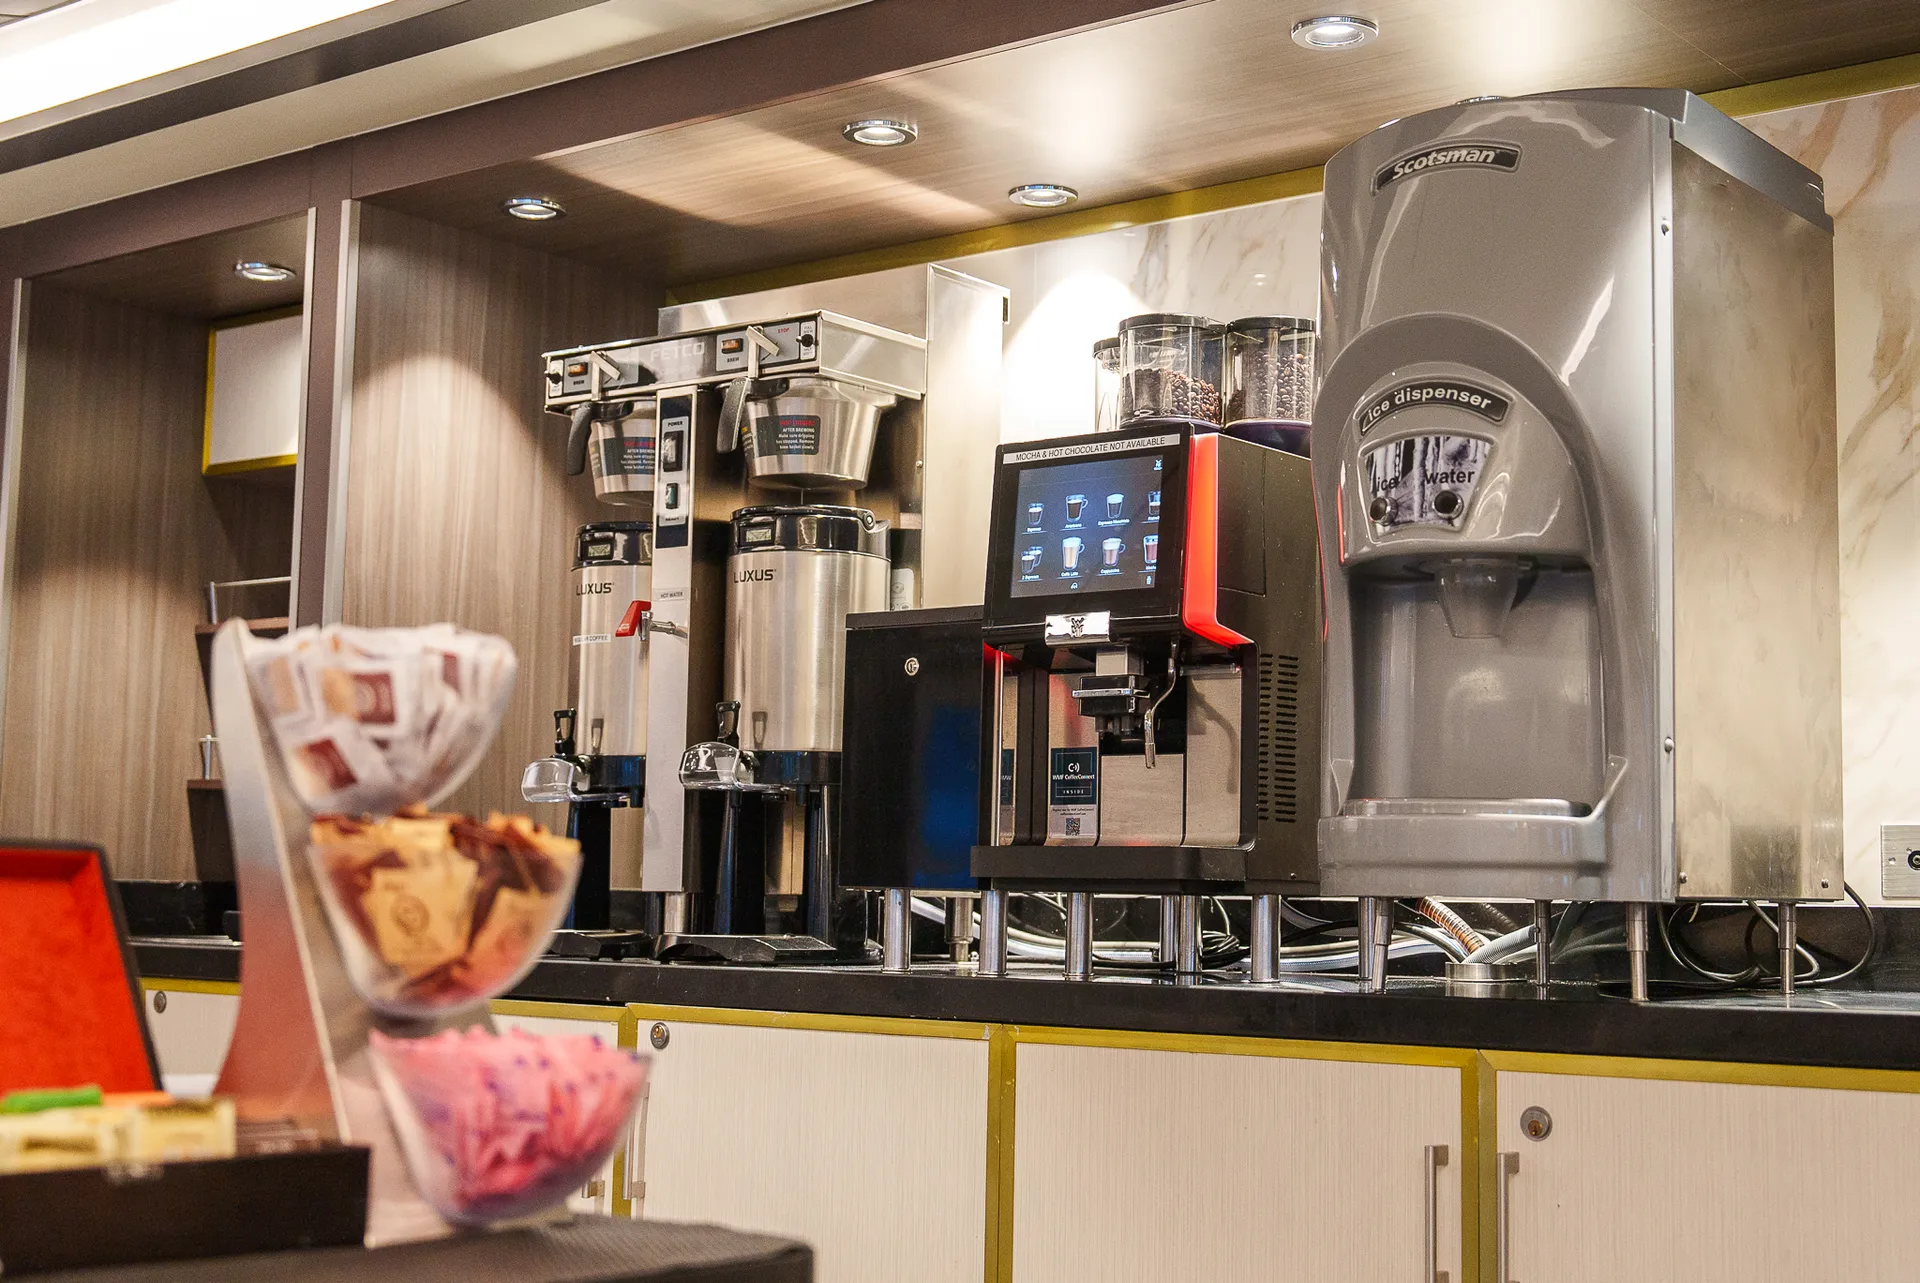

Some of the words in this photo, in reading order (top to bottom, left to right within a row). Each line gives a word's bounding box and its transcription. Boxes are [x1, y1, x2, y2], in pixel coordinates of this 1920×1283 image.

[1392, 150, 1496, 180] Scotsman
[650, 342, 704, 361] FETCO
[1368, 400, 1390, 421] ice
[1394, 388, 1492, 409] dispenser
[1016, 452, 1040, 461] MOCHA
[1048, 449, 1063, 457] HOT
[1065, 444, 1108, 456] CHOCOLATE
[1110, 442, 1125, 450] NOT
[1126, 437, 1165, 448] AVAILABLE
[1377, 476, 1399, 492] ice
[1424, 470, 1475, 484] water
[734, 569, 774, 583] LUXUS
[576, 583, 612, 596] LUXUS
